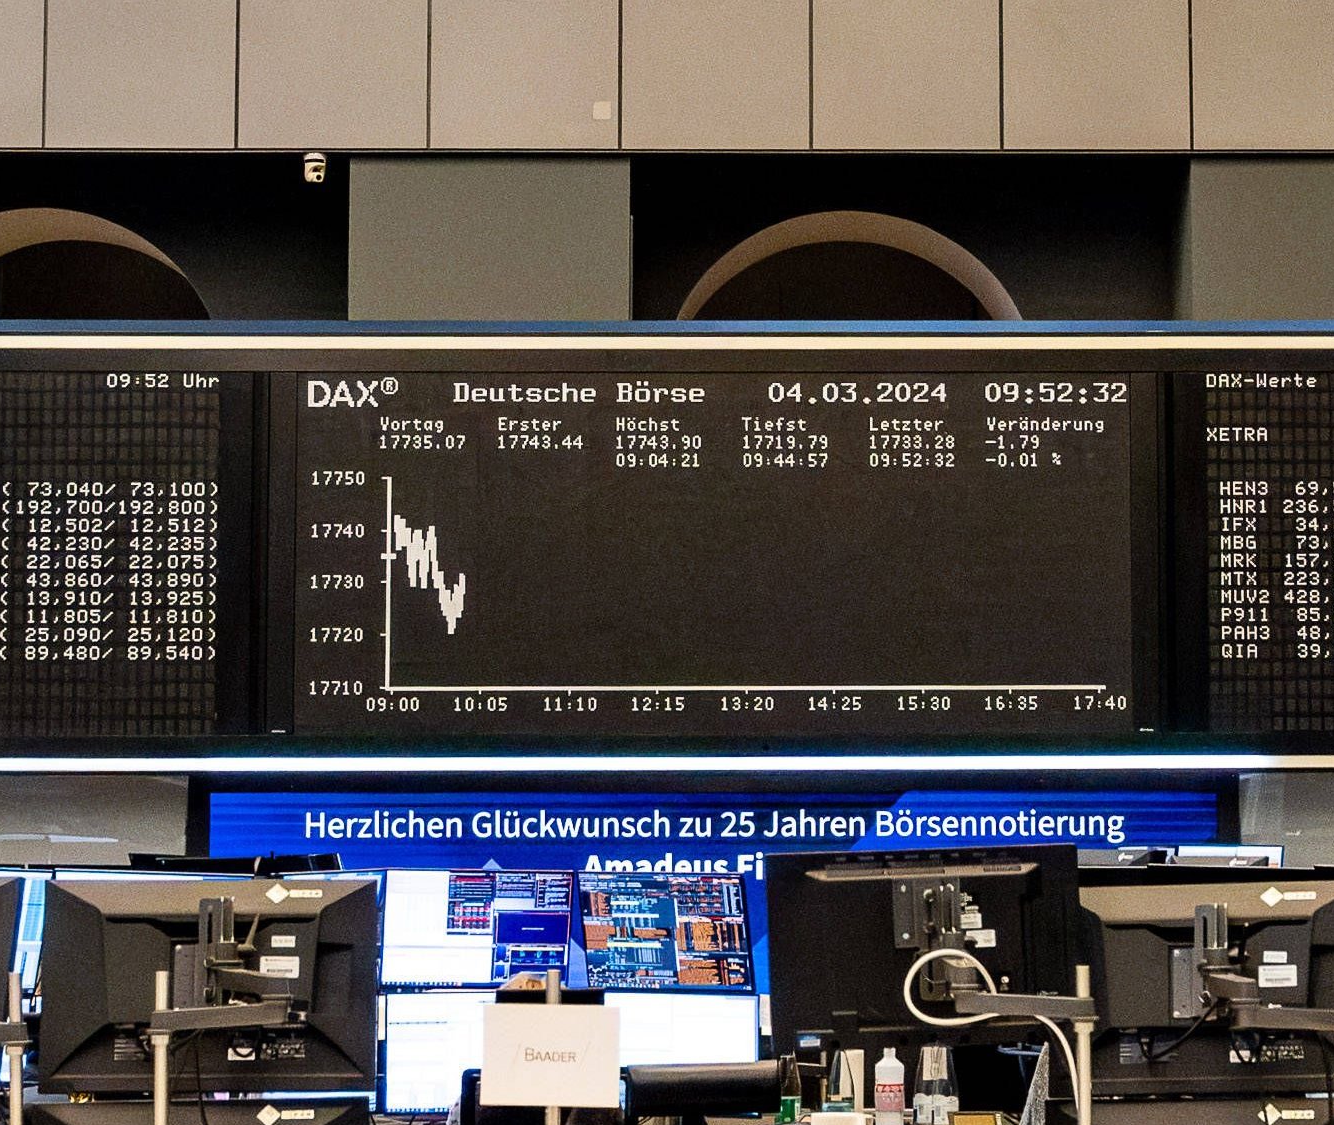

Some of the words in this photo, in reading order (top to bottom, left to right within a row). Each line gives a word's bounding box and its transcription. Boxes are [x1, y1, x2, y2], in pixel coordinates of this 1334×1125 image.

[106, 373, 169, 389] 09:52
[183, 372, 220, 388] Uhr
[1205, 373, 1317, 388] DAX-Werte
[452, 382, 597, 403] Deutsche
[615, 380, 706, 404] Börse
[768, 382, 947, 405] 04.03.2024
[984, 382, 1127, 405] 09:52:32
[380, 416, 444, 434] Vortag
[497, 416, 562, 432] Erster
[615, 416, 680, 432] Höchst
[741, 416, 807, 432] Tiefst
[869, 416, 944, 432] Letzter
[986, 416, 1105, 433] Veränderung
[1206, 427, 1268, 442] XETRA
[615, 452, 700, 468] 09:04:21
[742, 452, 829, 468] 09:44:57
[869, 452, 955, 468] 09:52:32
[311, 470, 365, 486] 17750
[1219, 498, 1267, 514] HNR1
[311, 523, 365, 539] 17740
[1221, 516, 1257, 532] IFX
[310, 574, 364, 590] 17730
[1220, 589, 1270, 604] MUV2
[309, 627, 364, 643] 17720
[309, 680, 363, 696] 17710
[366, 696, 420, 712] 09:00
[453, 696, 508, 712] 10:05
[543, 696, 597, 712] 11:10
[631, 696, 685, 712] 12:15
[721, 696, 774, 711] 13:20
[808, 695, 862, 711] 14:25
[897, 695, 951, 711] 15:30
[984, 695, 1038, 711] 16:35
[1074, 695, 1127, 711] 17:40
[305, 811, 463, 838] Herzlichen
[472, 810, 670, 838] Glückwunsch
[679, 818, 711, 838] zu
[721, 811, 755, 837] 25
[764, 810, 866, 837] Jahren
[875, 809, 1125, 843] Börsennotierung
